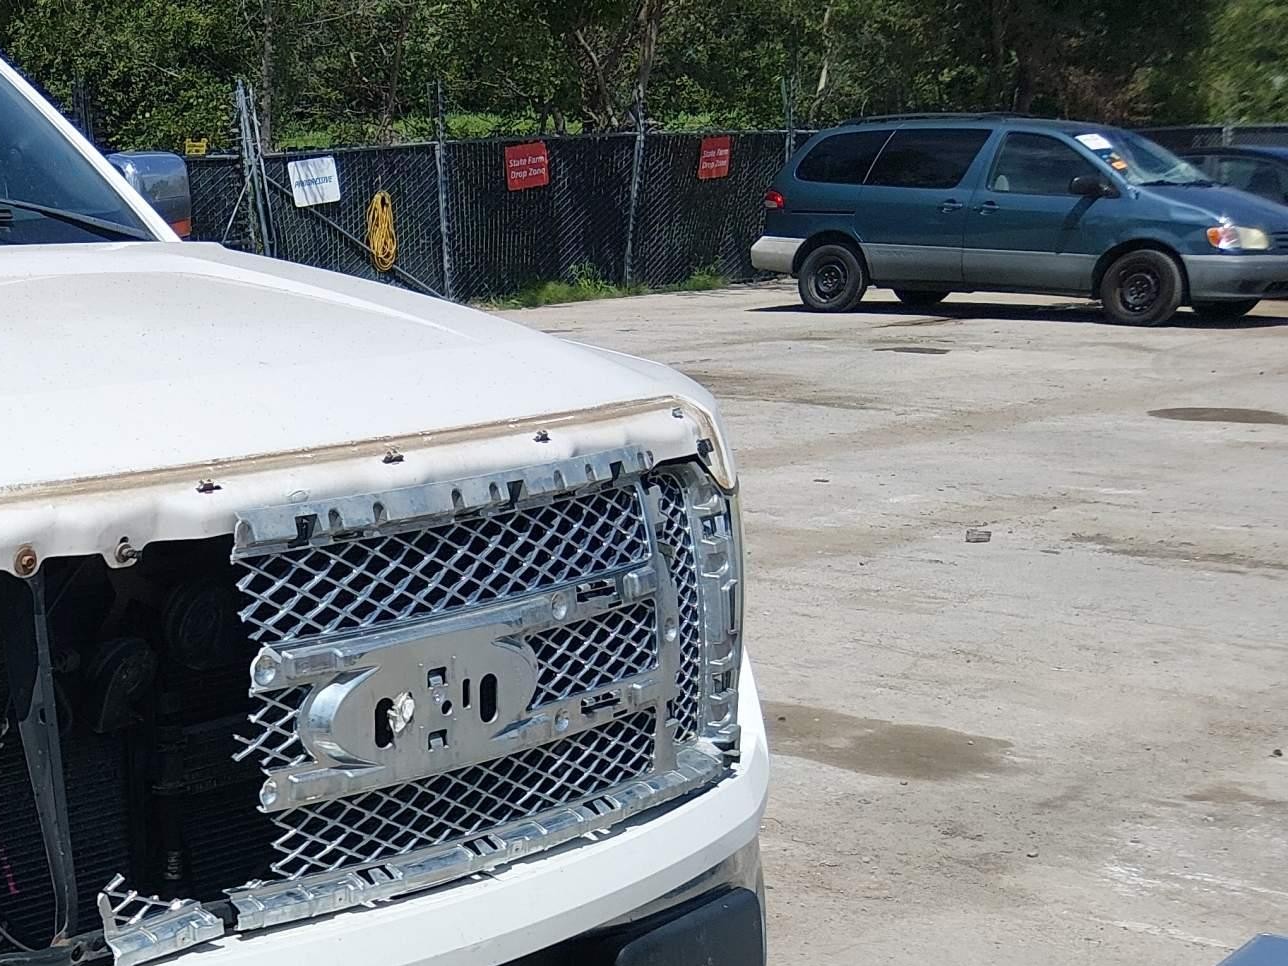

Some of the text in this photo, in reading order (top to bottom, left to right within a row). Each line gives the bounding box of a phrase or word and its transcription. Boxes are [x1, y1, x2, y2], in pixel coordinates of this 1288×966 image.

[509, 156, 544, 168] State Farm
[511, 167, 545, 179] Drop Zone
